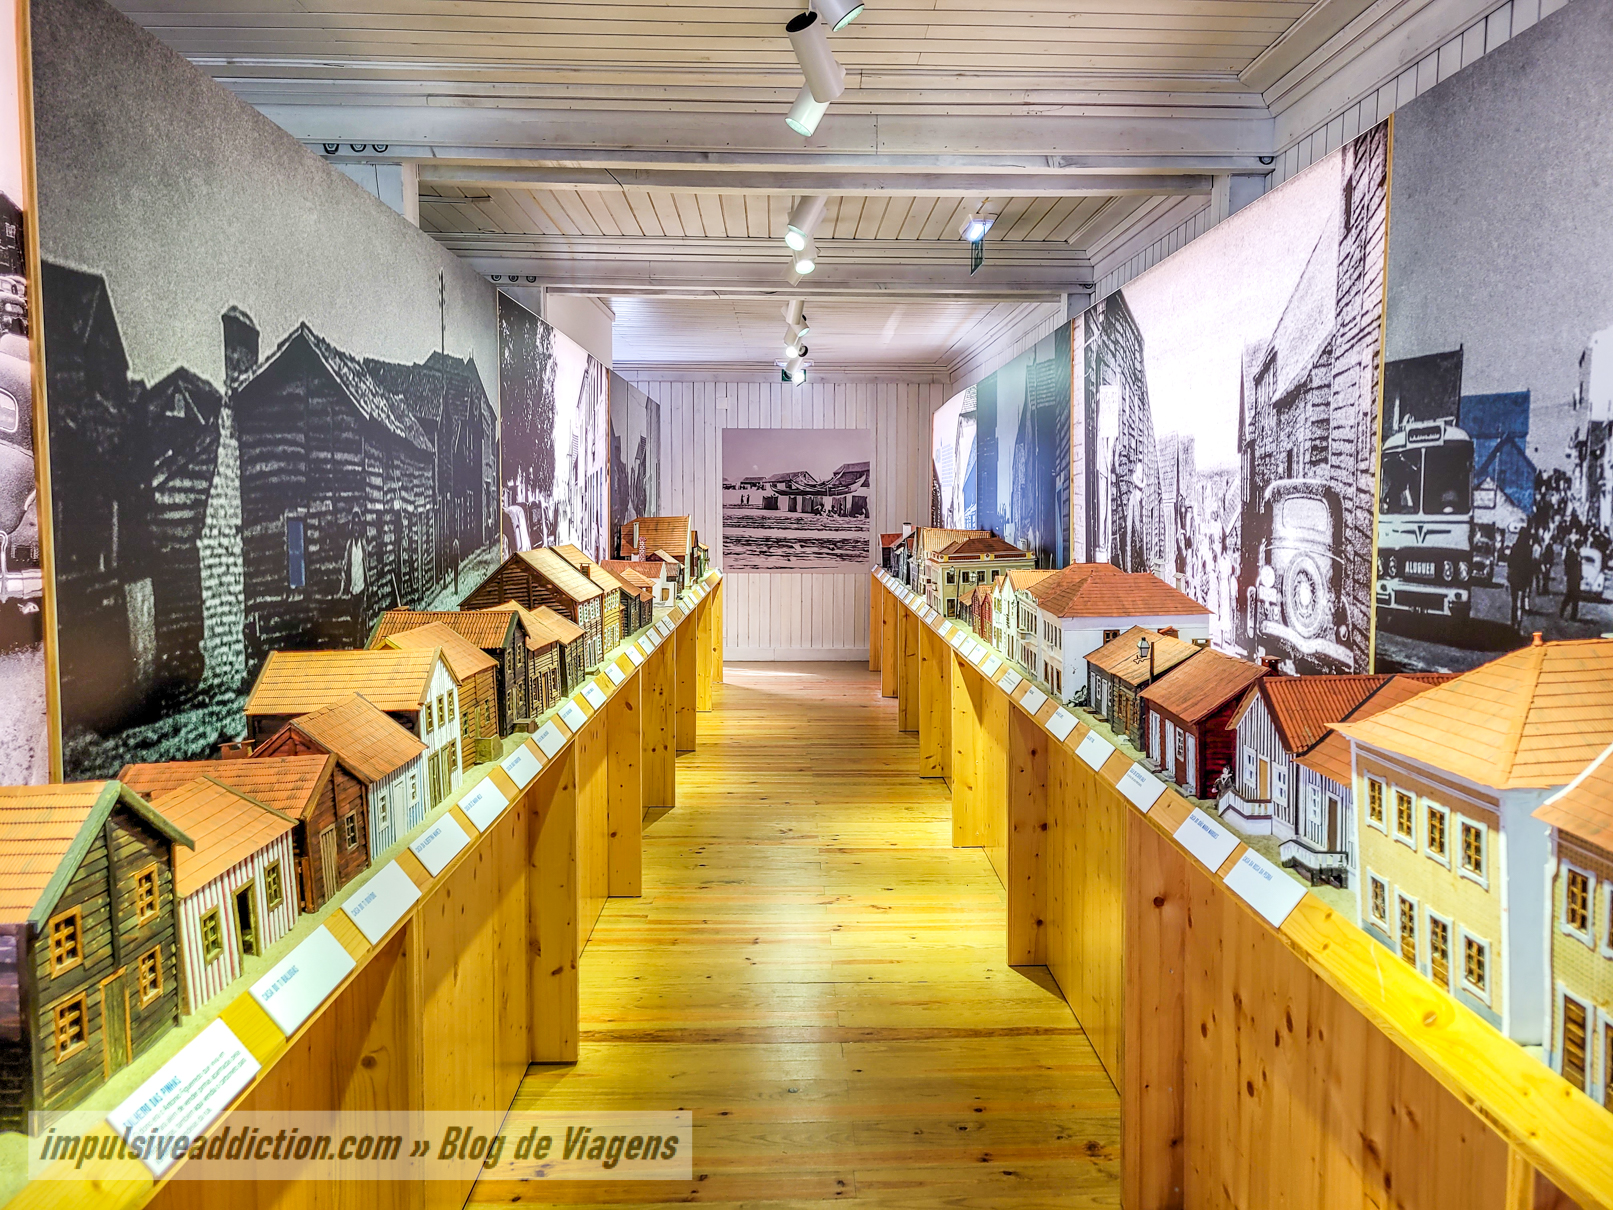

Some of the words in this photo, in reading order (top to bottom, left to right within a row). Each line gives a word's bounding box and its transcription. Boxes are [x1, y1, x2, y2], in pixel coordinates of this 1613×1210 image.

[1405, 561, 1435, 575] ALUGUER
[262, 988, 274, 1002] CASA
[149, 1092, 163, 1107] DAS
[160, 1075, 182, 1097] PINHAS
